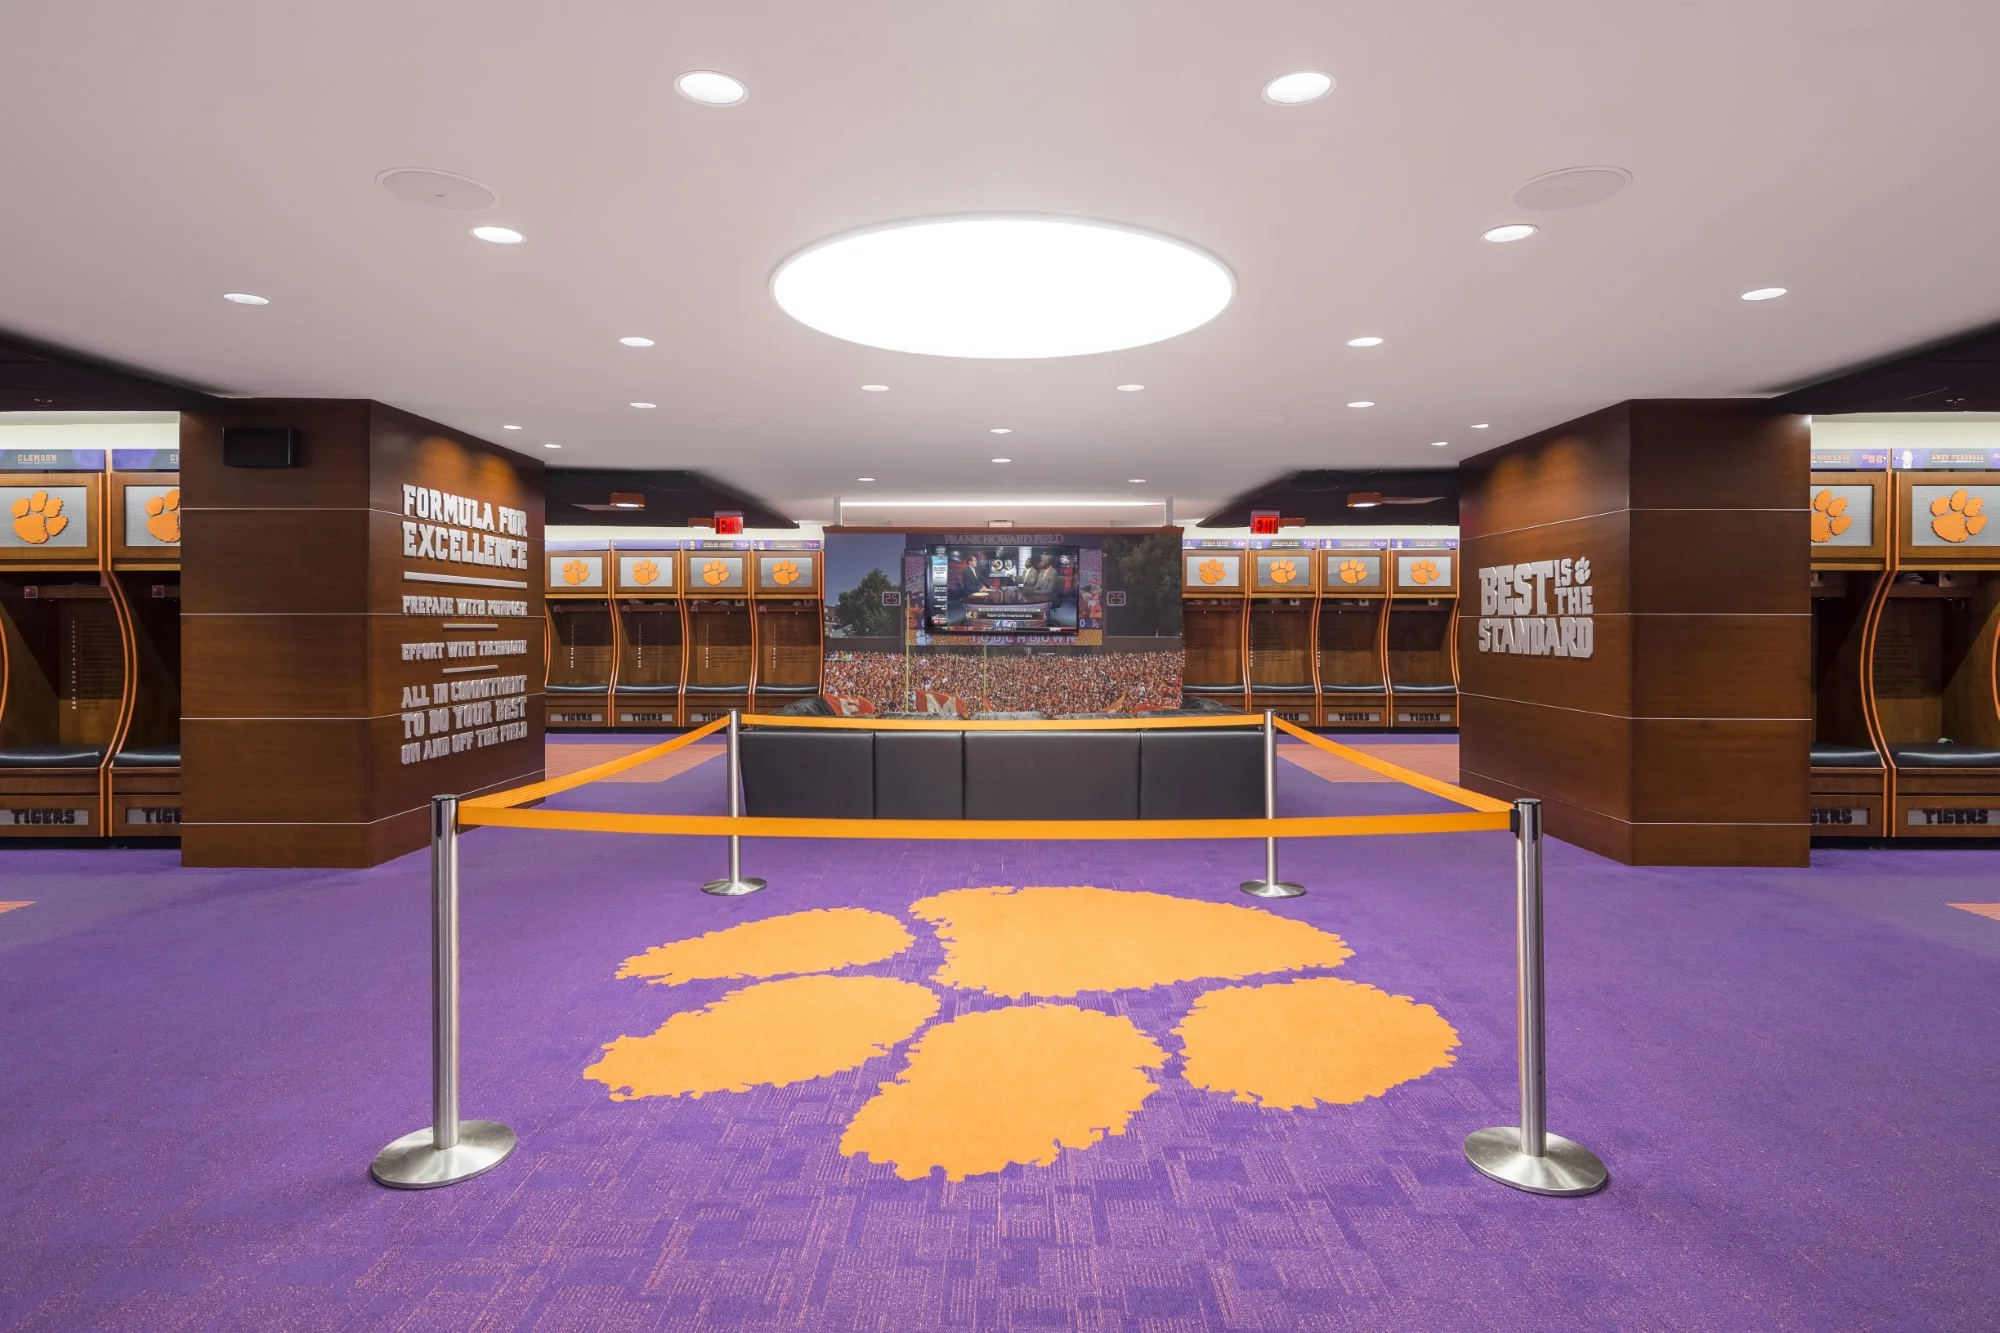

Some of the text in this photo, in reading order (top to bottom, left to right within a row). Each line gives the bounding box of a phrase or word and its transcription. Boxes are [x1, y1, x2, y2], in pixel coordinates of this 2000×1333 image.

[18, 454, 57, 462] CLEMSON
[403, 484, 527, 537] FORMULA FOR
[1255, 517, 1277, 534] EXIT
[402, 521, 527, 570] EXCELLENCE
[944, 534, 1064, 544] FRANK HOWARD FIELD
[1479, 558, 1572, 616] BEST IS
[402, 595, 527, 617] PREPARE WITH PURPOSE
[1554, 586, 1593, 615] THE
[971, 634, 1076, 643] TOUCHDOWN
[1479, 617, 1593, 658] STANDARD
[401, 639, 527, 661] EFFORT WITH TECHNIQUE
[402, 675, 527, 709] ALL IN COMMITMENT
[402, 696, 526, 739] TO DO YOUR BEST
[561, 713, 592, 722] TIGERS
[631, 713, 662, 722] TIGERS
[1338, 713, 1370, 722] TIGERS
[1409, 713, 1441, 722] TIGERS
[401, 721, 528, 765] ON AND OFF THE FIELD
[11, 808, 75, 824] TIGERS
[142, 808, 181, 824] TIGE
[1810, 808, 1852, 824] GERS
[1923, 809, 1989, 824] TIGERS
